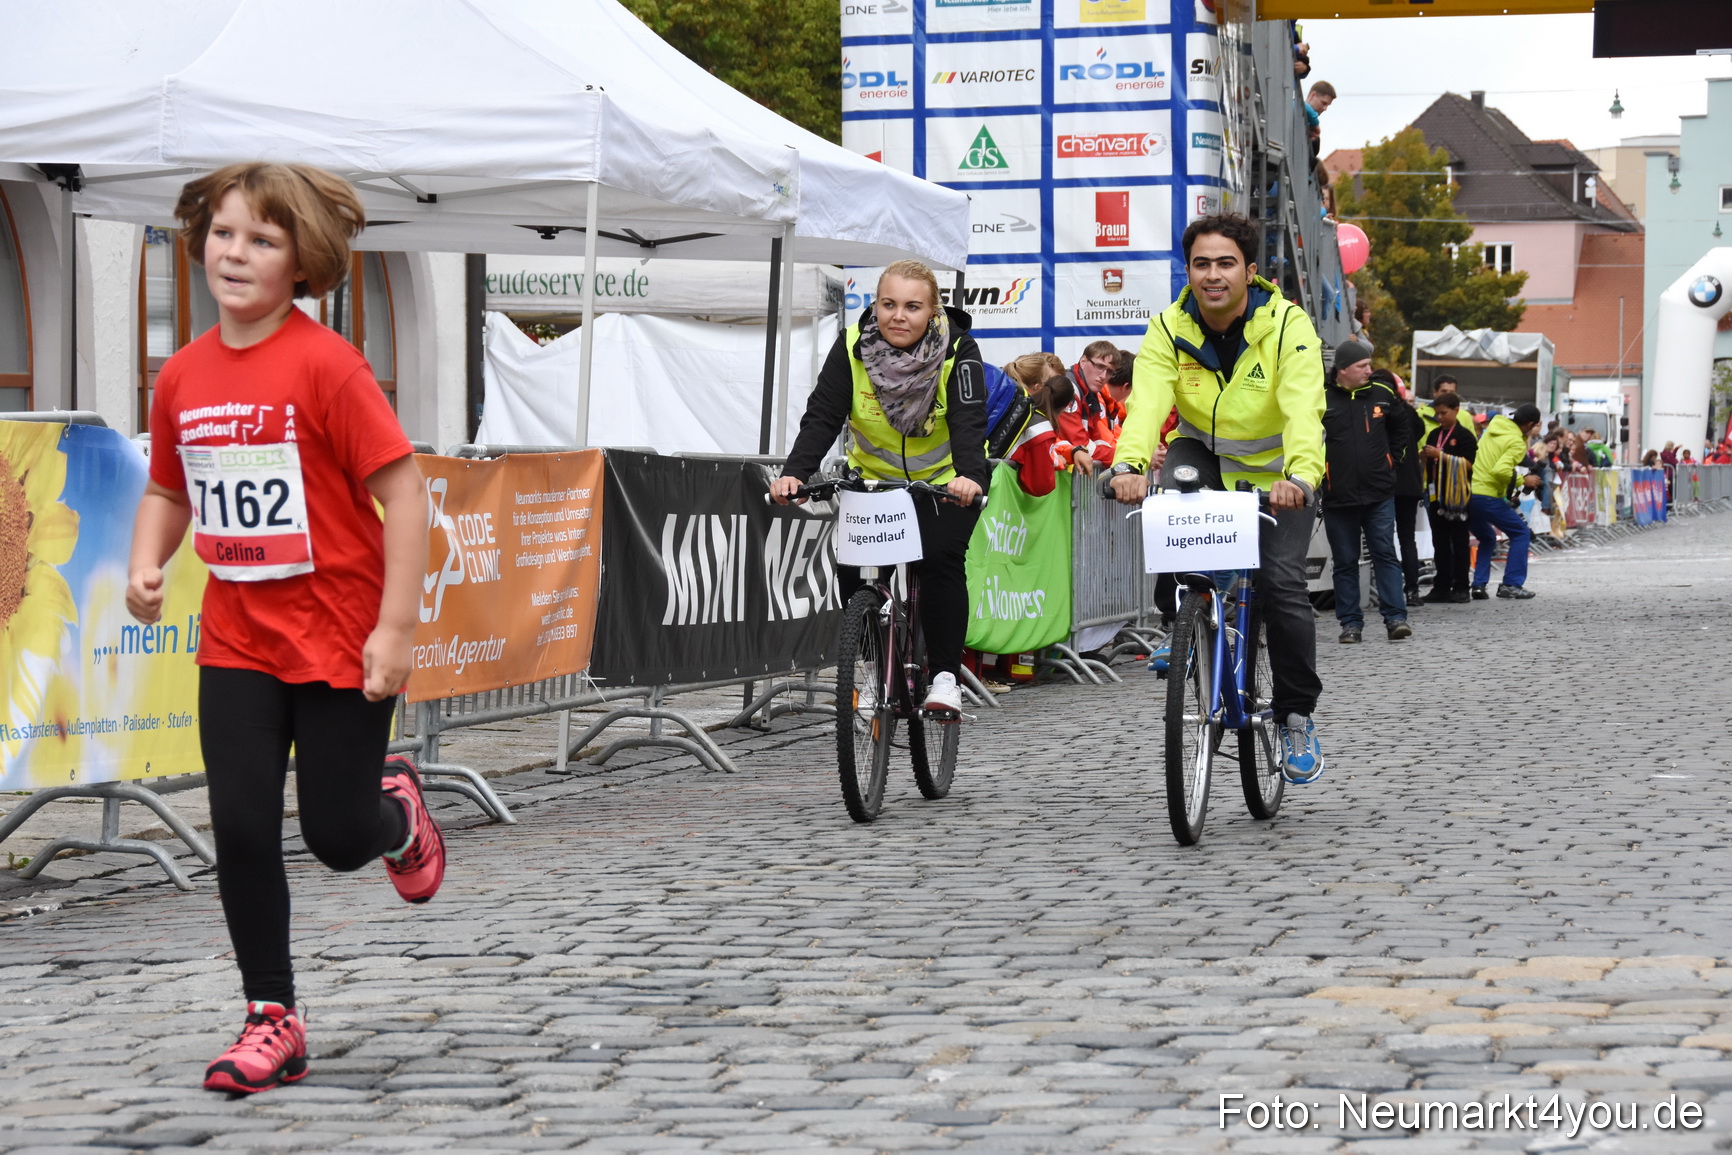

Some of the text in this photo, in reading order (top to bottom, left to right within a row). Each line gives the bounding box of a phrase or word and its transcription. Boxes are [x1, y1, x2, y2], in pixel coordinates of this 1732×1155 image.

[960, 69, 1035, 84] VARIOTEC
[859, 88, 908, 99] energie
[1115, 80, 1165, 91] energie
[1061, 134, 1137, 152] charivari
[1096, 222, 1126, 237] Braun
[486, 268, 649, 298] eudeservce.de
[978, 307, 1018, 315] neumarkt
[1086, 298, 1141, 307] Neumarkter
[1077, 308, 1150, 320] Lammsbräu
[179, 402, 255, 424] Neumarkter
[181, 420, 238, 444] Stadtlauf
[219, 448, 287, 467] BOCK
[567, 487, 590, 500] Partner
[194, 478, 293, 528] 7162
[846, 512, 907, 525] Erster Mann
[1168, 513, 1234, 526] Erste Frau
[458, 512, 495, 546] CODE
[554, 531, 567, 542] was
[848, 529, 905, 546] Jugendlauf
[1165, 531, 1238, 549] Jugendlauf
[216, 542, 266, 561] Celina
[466, 548, 501, 583] CLINIC
[662, 513, 748, 625] MINI
